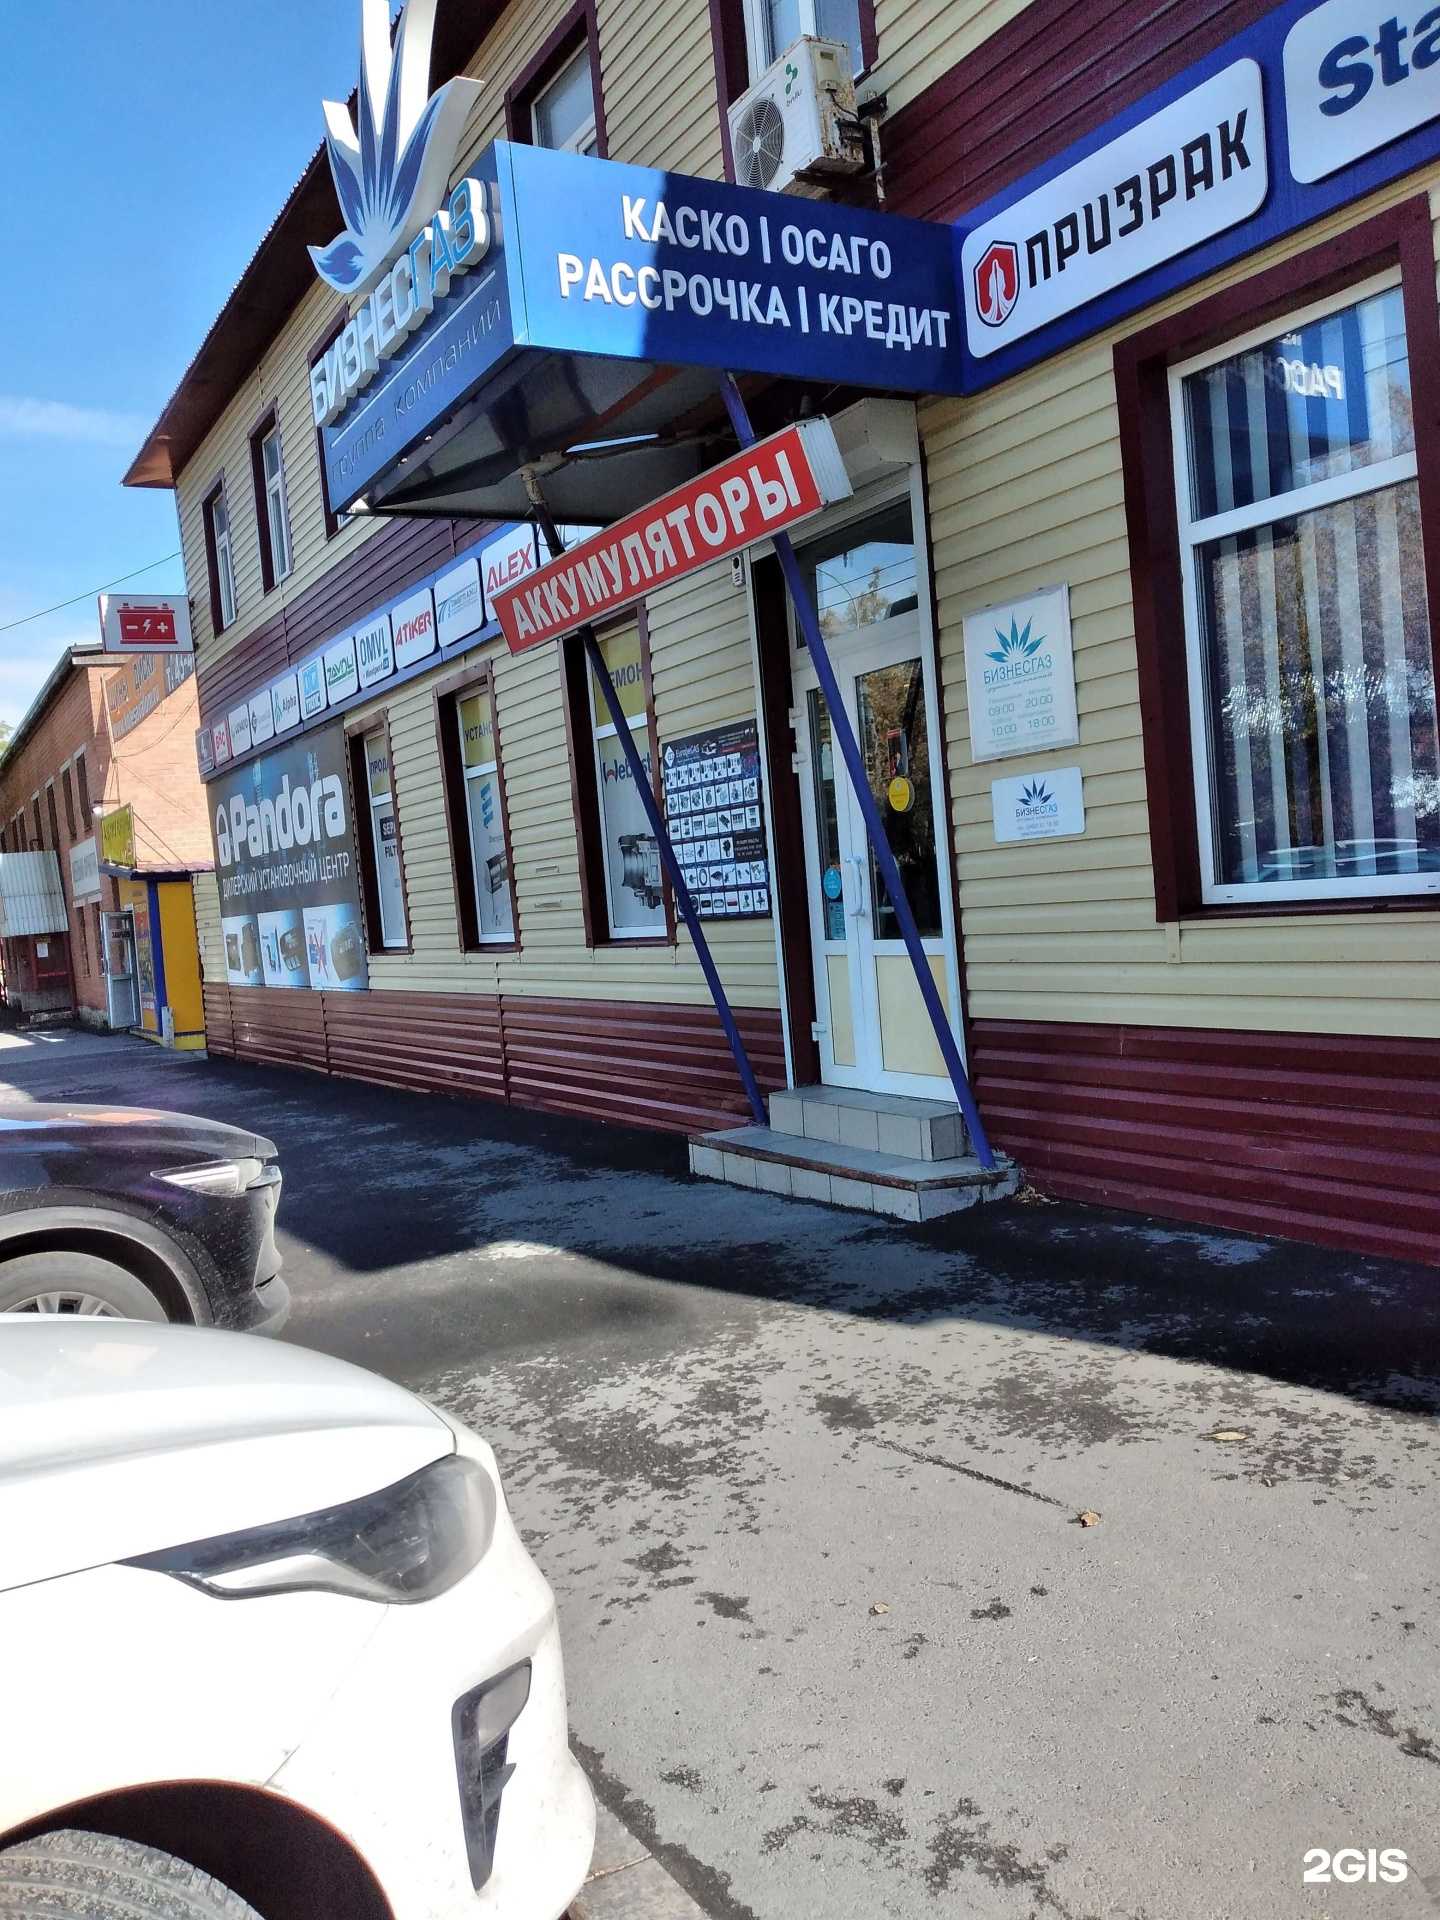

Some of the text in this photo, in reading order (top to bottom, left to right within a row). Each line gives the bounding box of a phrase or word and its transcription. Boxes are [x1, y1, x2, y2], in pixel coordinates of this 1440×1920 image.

[1025, 107, 1252, 289] ПРИЗРАК
[622, 194, 750, 257] КАСКО
[781, 224, 892, 280] ОСАГО
[309, 178, 491, 428] БИЗНЕСГАЗ
[557, 252, 791, 328] РАССРОЧКА
[820, 294, 951, 352] КРЕДИТ
[393, 299, 502, 422] компаний
[486, 542, 533, 594] ALEX
[511, 450, 802, 640] АККУМУЛЯТОРЫ
[360, 627, 388, 667] OMVL
[395, 610, 432, 647] ATIKER
[608, 661, 645, 689] ЕМОН
[983, 654, 1053, 685] БИЗНЕСГАЗ
[369, 758, 389, 774] ПРОД
[602, 752, 652, 785] Webst
[230, 774, 346, 862] Pandora
[1015, 803, 1058, 818] БИЗНЕСГАЗ
[223, 852, 350, 900] ДИЛЕРСКИЙ УСТАНОВОЧНЫЙ ЦЕНТР
